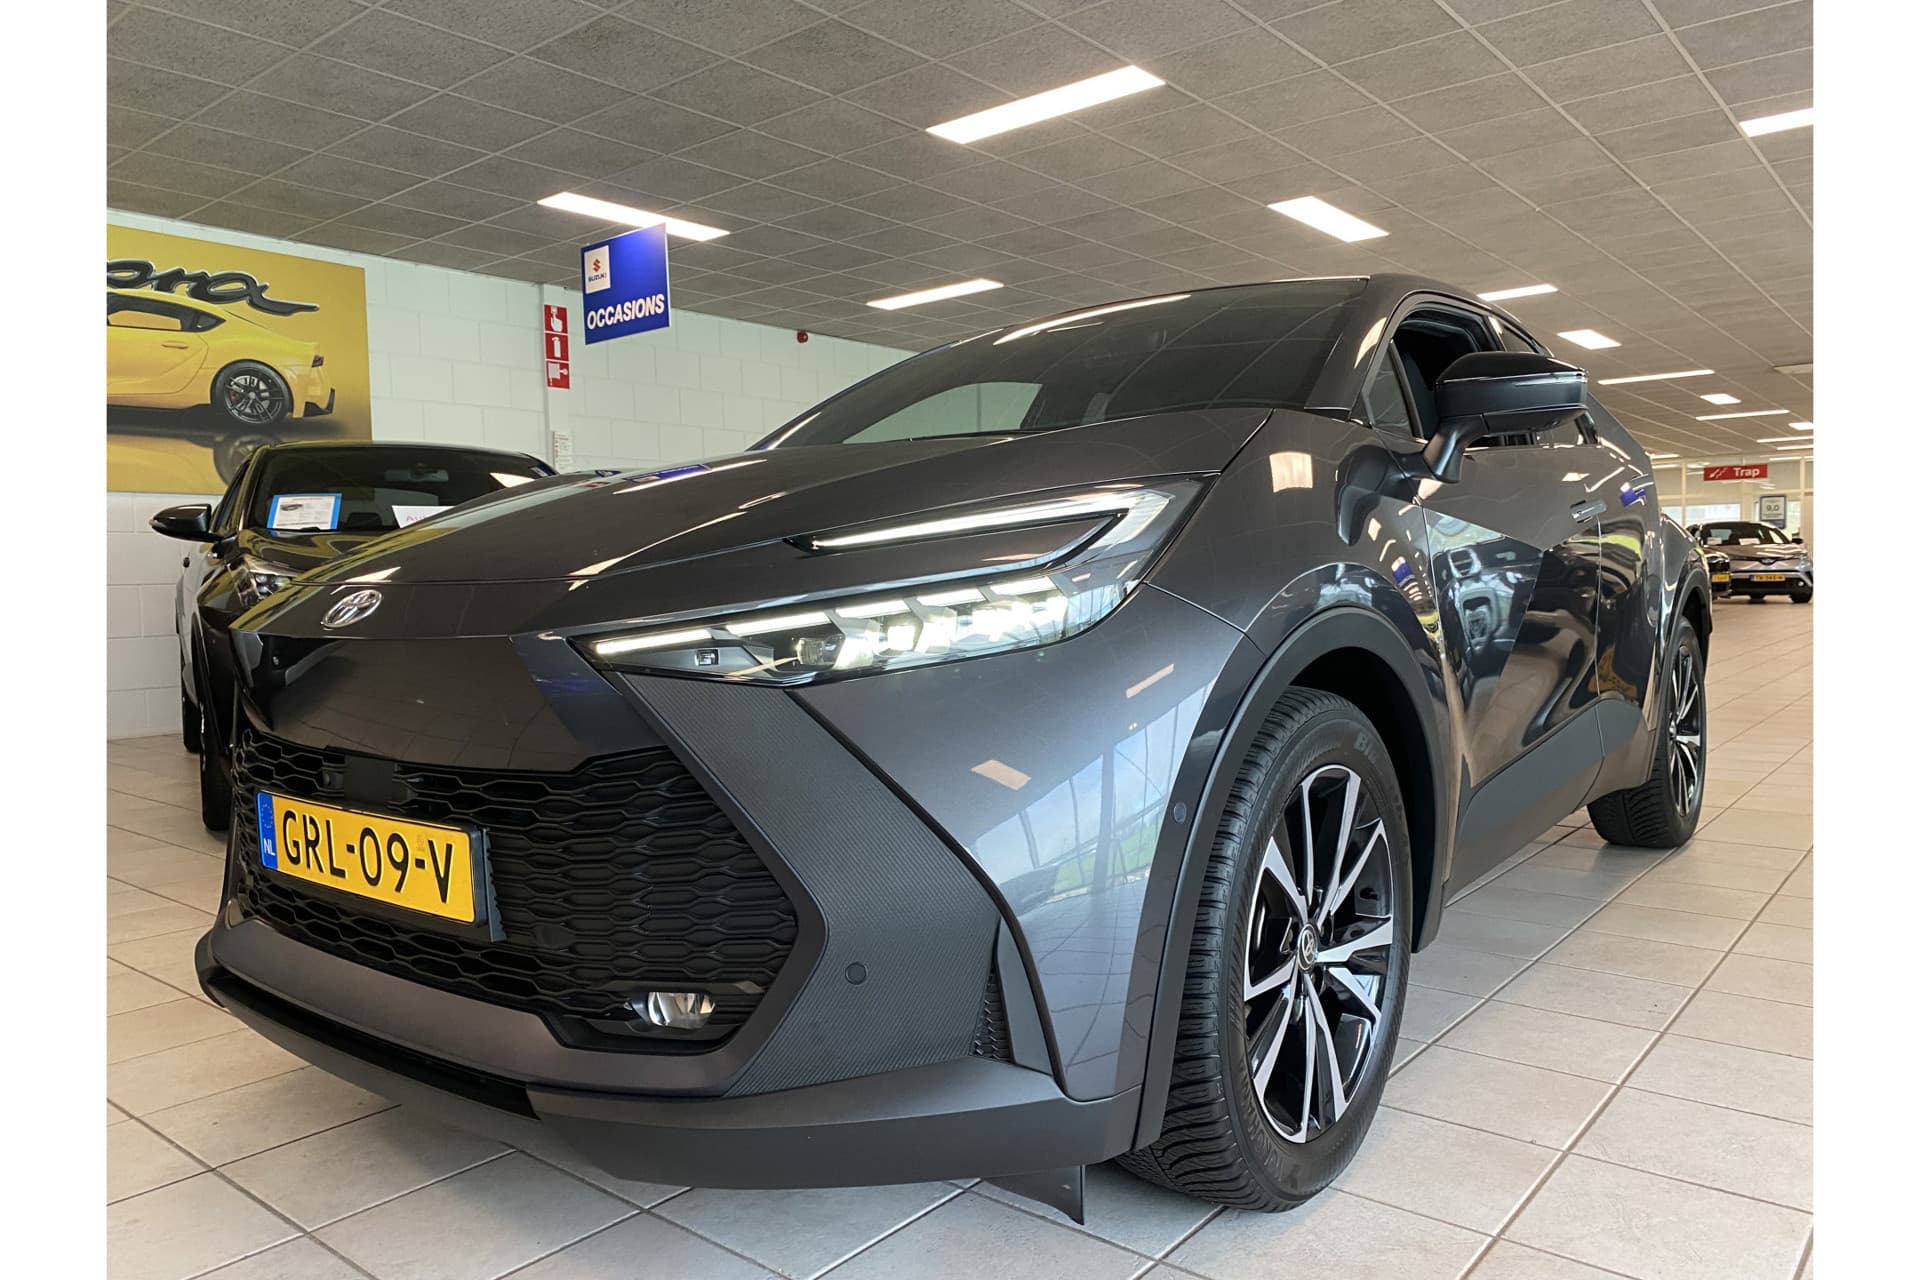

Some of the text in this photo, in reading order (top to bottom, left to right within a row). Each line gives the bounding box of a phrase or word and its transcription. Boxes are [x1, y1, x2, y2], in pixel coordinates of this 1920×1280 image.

[588, 272, 607, 283] SUZUKI
[586, 293, 665, 330] OCCASIONS
[1733, 467, 1760, 478] Trap
[264, 838, 276, 856] NL
[282, 810, 453, 904] GRL-09-V
